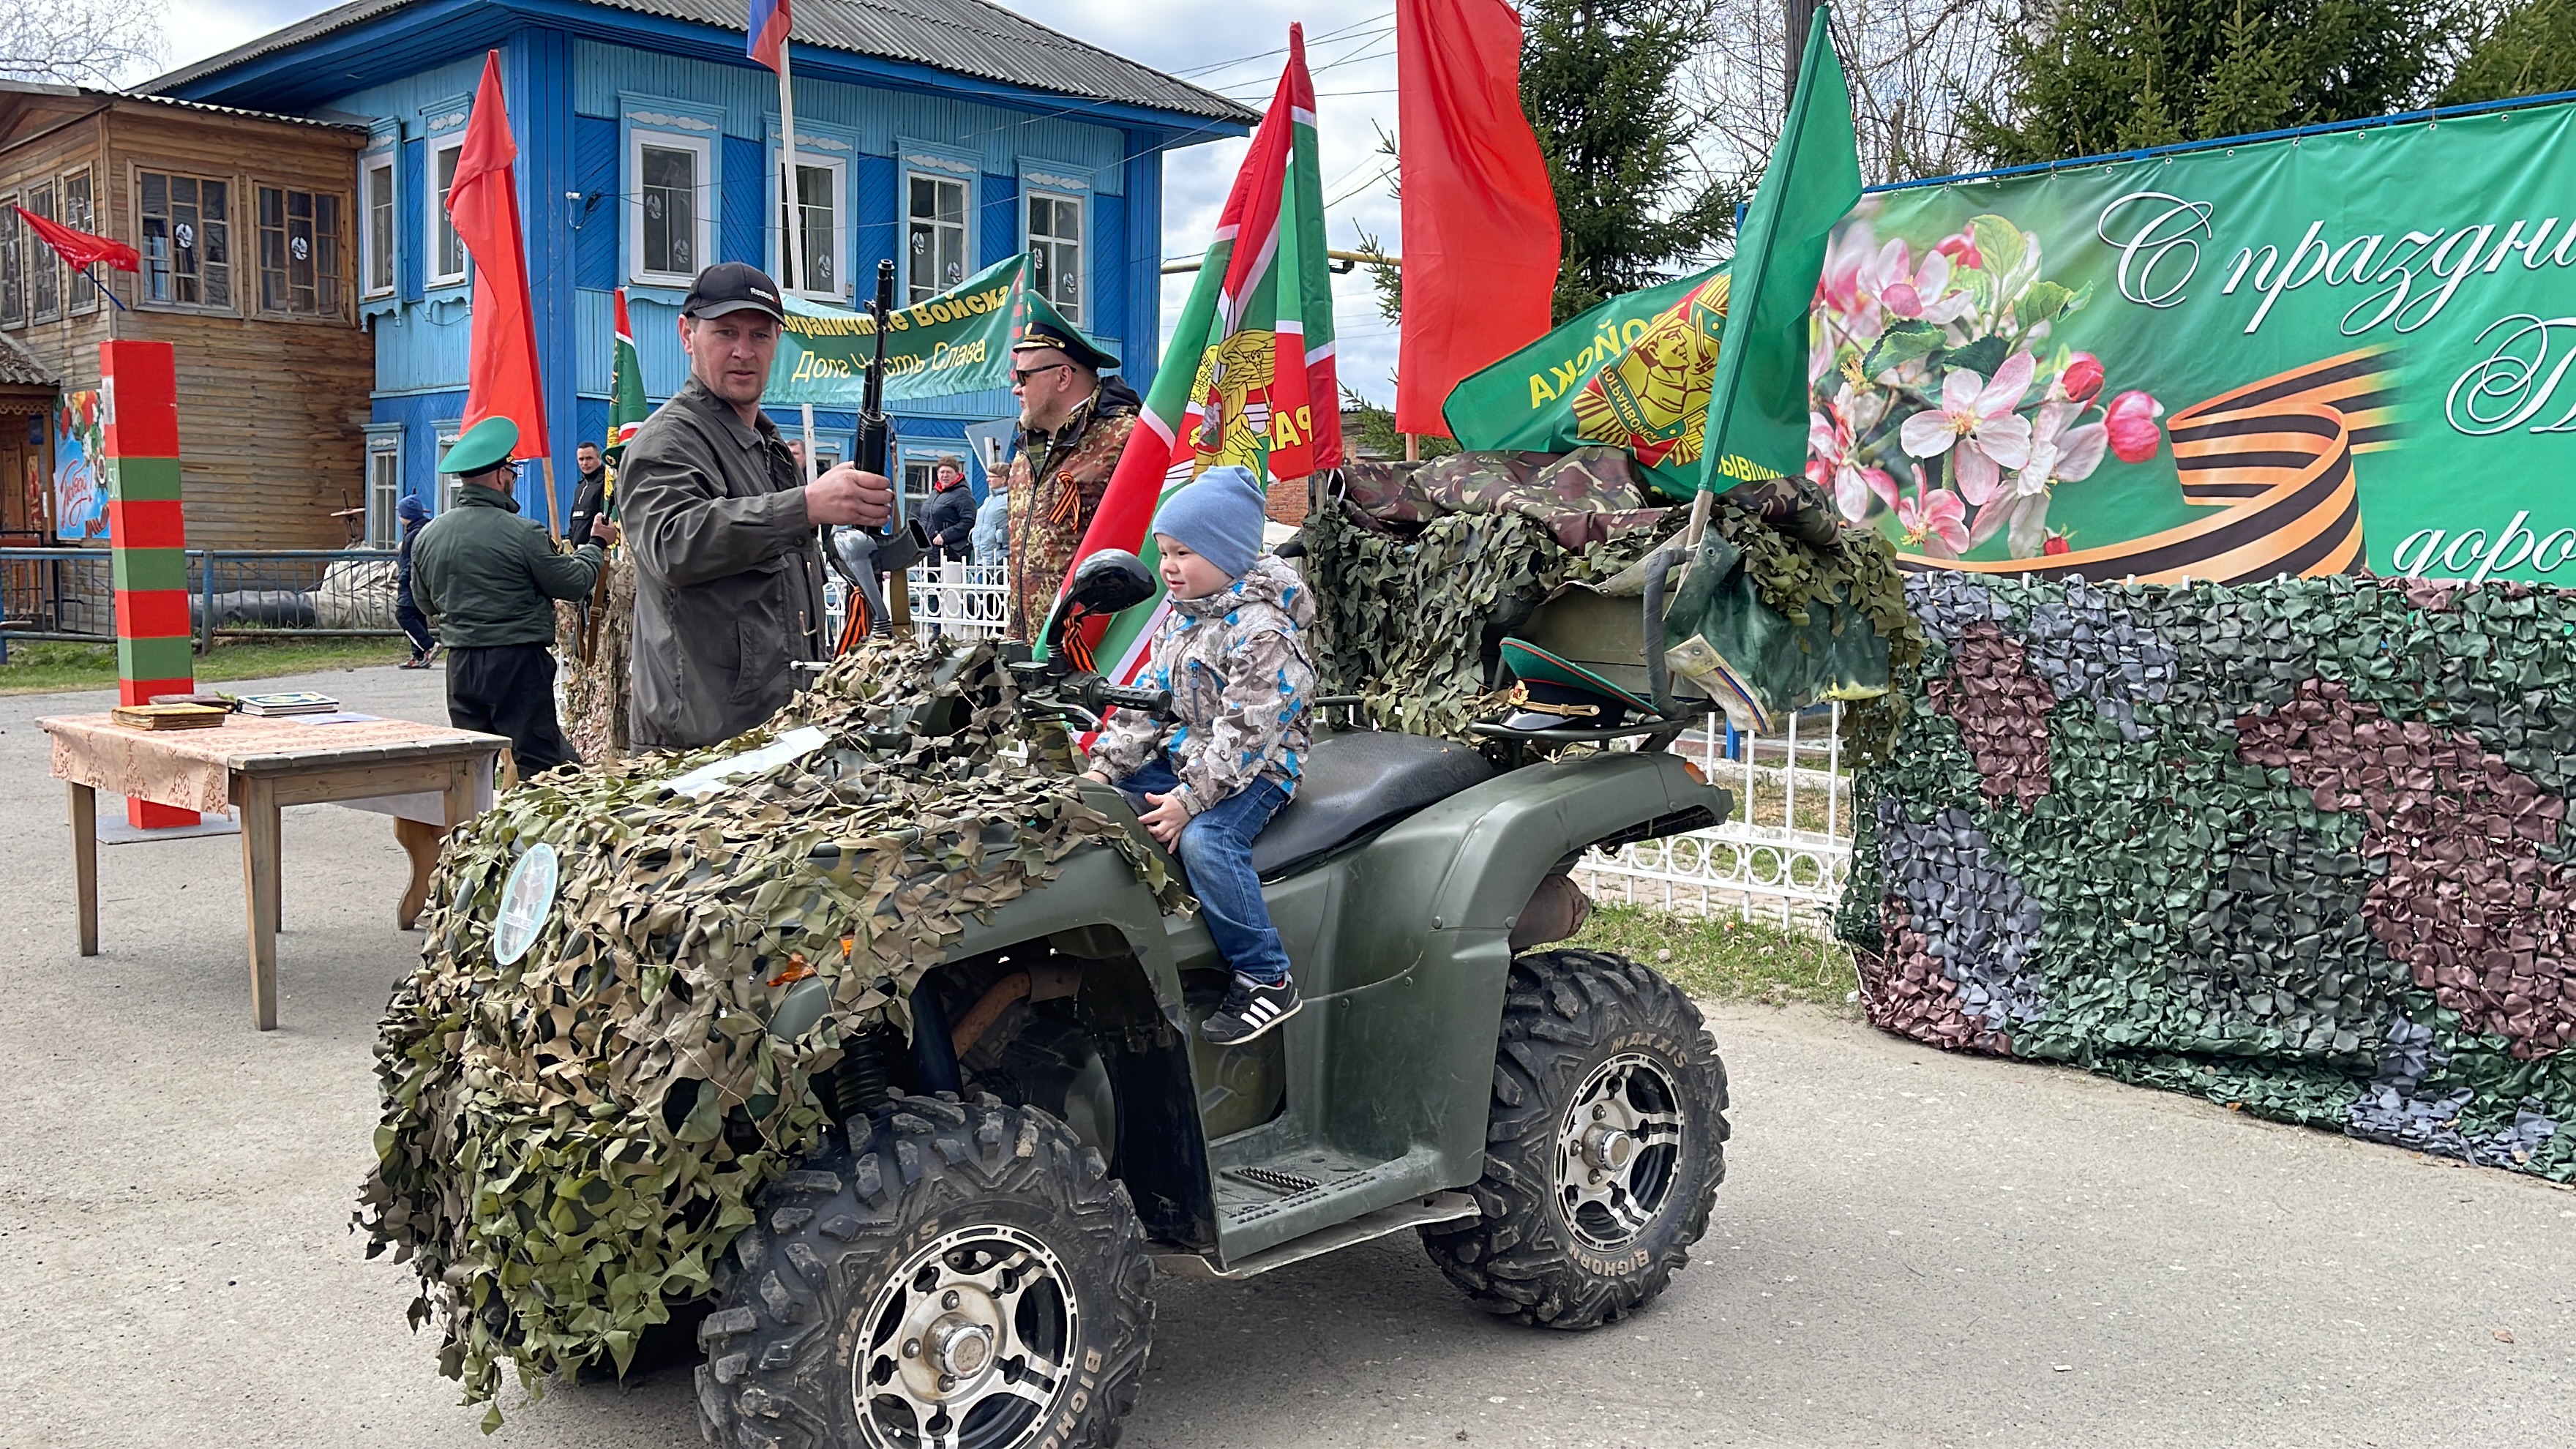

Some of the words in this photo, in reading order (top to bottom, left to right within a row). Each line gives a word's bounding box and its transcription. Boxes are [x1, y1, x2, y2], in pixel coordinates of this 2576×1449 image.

[2097, 191, 2214, 308] С
[782, 311, 909, 340] ограничне
[909, 285, 1010, 328] Войска
[791, 350, 851, 383] Долг
[850, 352, 926, 378] Чсть
[932, 338, 986, 371] Слава
[1610, 1031, 1689, 1068] MAXXIS
[1568, 1240, 1650, 1277] BIGHORN
